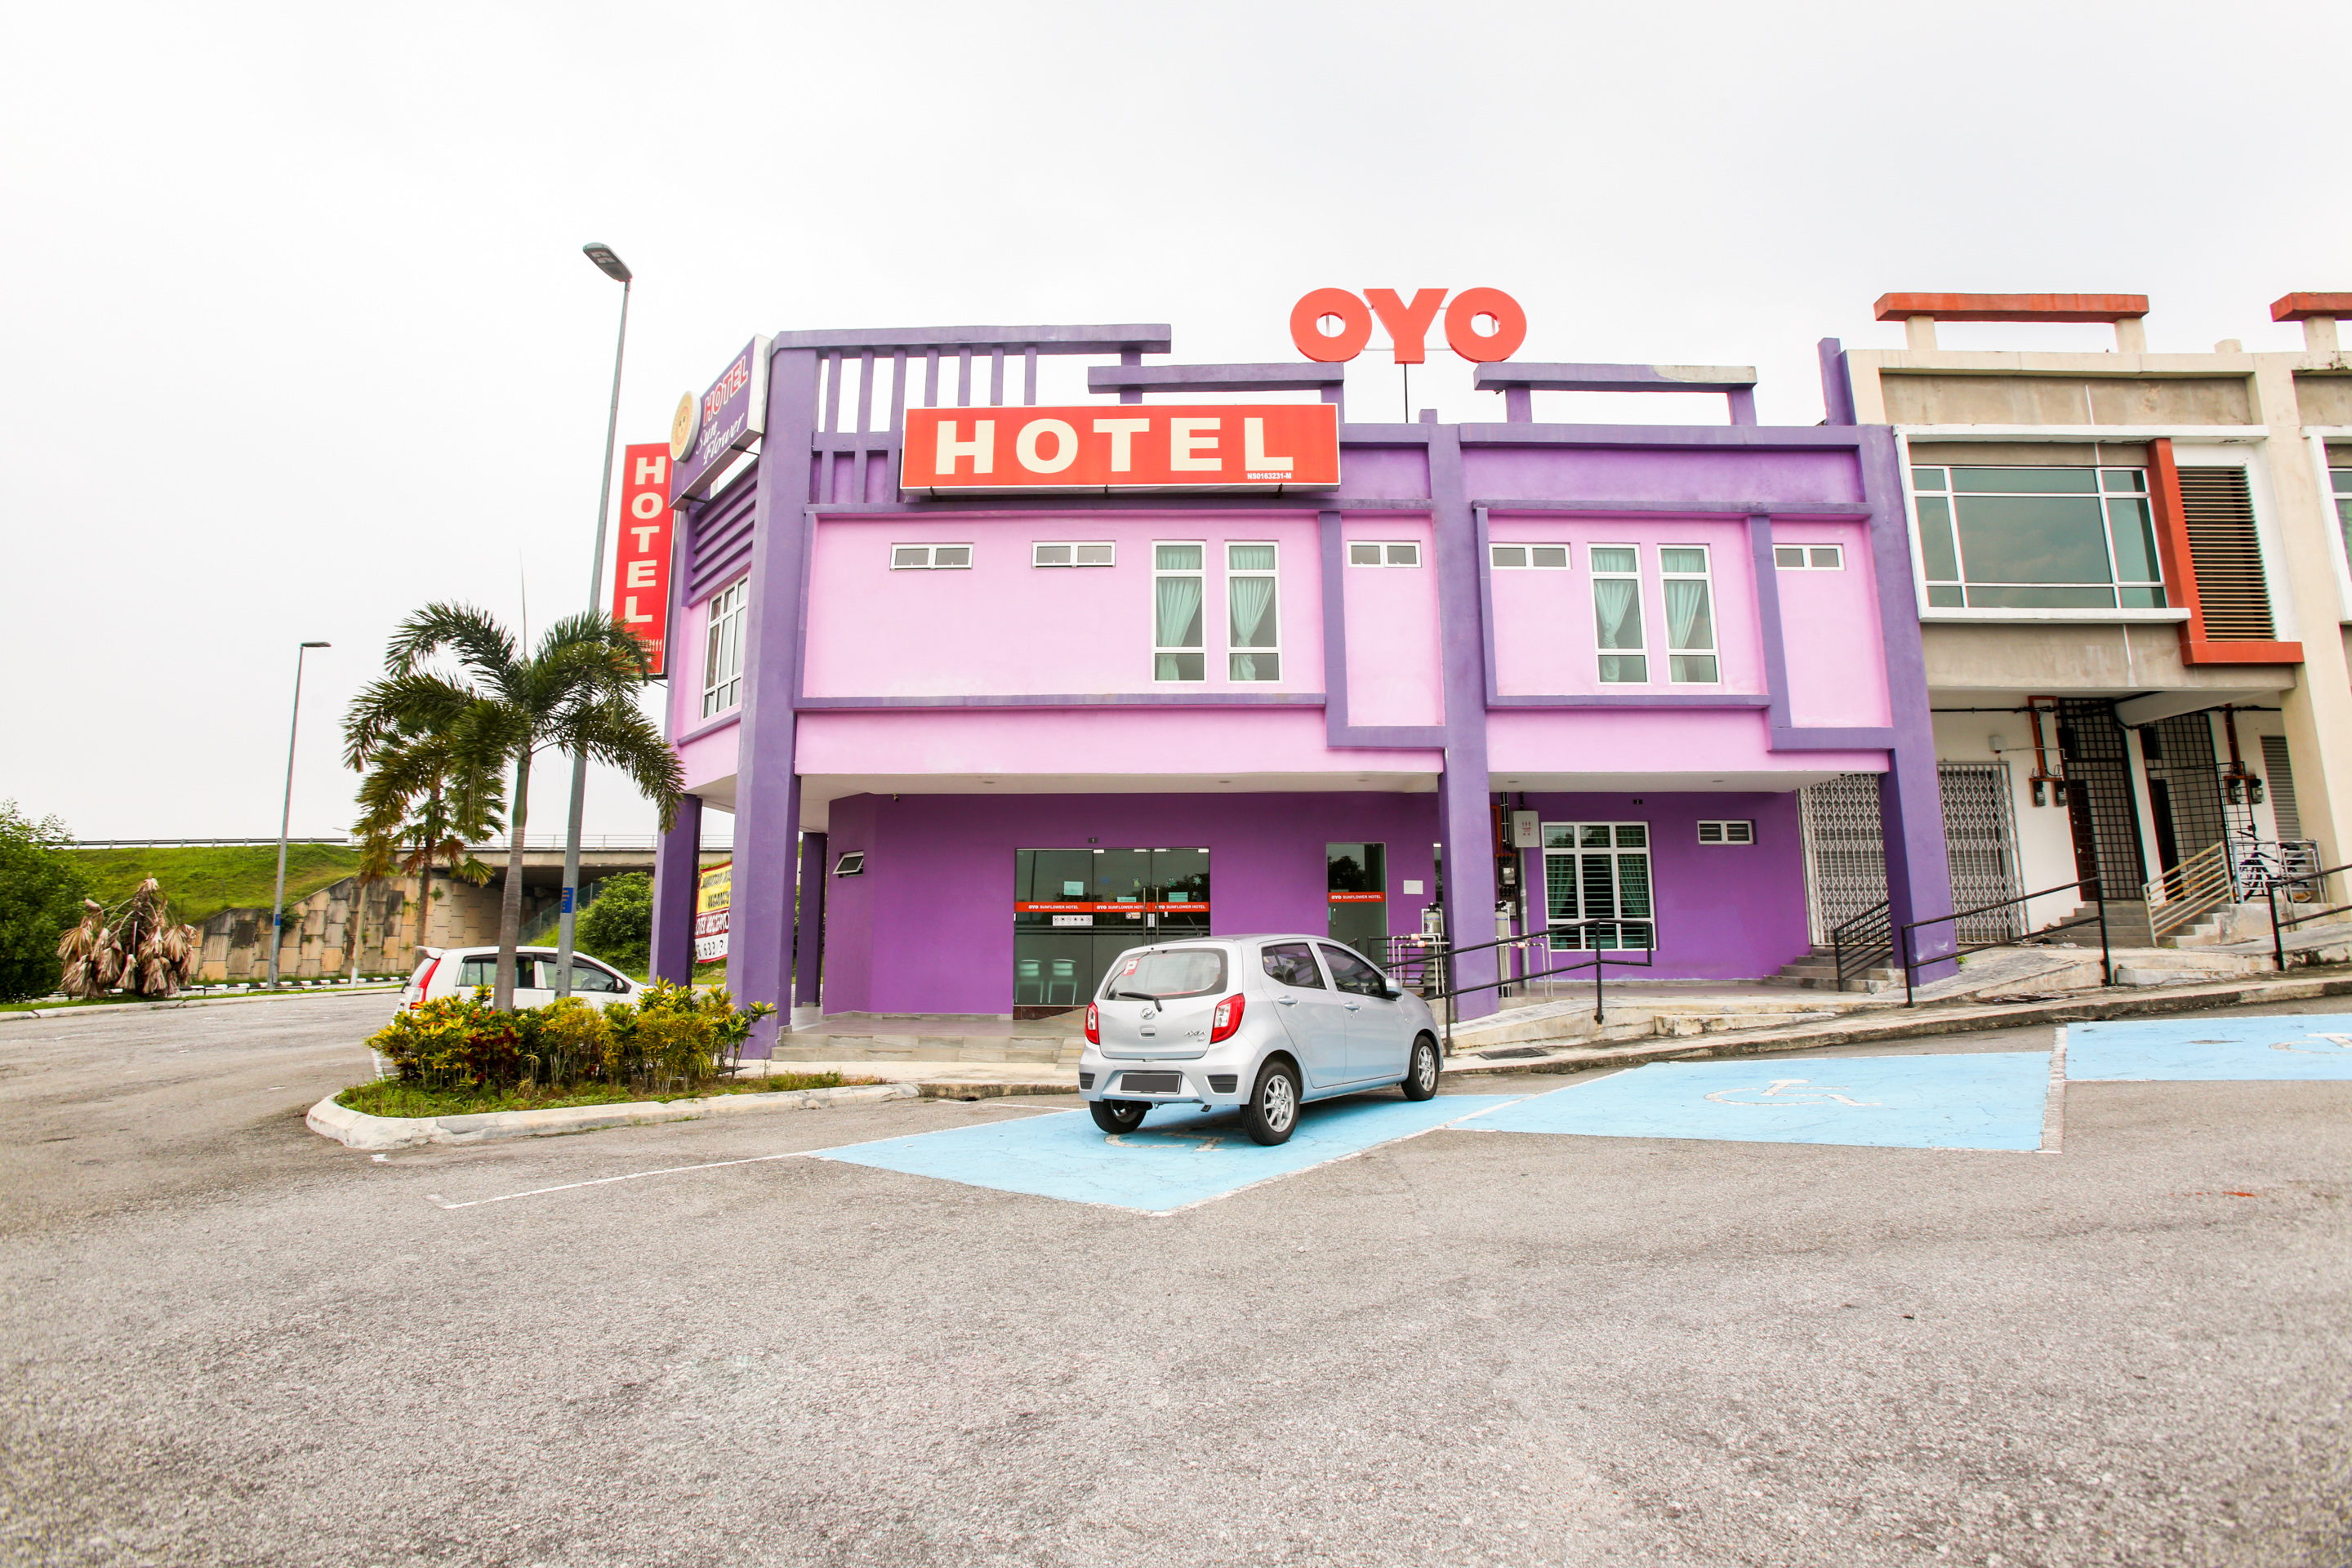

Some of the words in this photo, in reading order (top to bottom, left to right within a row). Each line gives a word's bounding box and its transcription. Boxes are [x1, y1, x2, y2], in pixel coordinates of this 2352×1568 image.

[1290, 287, 1527, 364] OYO
[702, 355, 748, 427] HOTEL
[696, 421, 718, 455] Sun
[703, 412, 745, 466] Flower
[935, 417, 1294, 474] HOTEL
[624, 456, 666, 623] HOTEL
[1123, 960, 1138, 974] P
